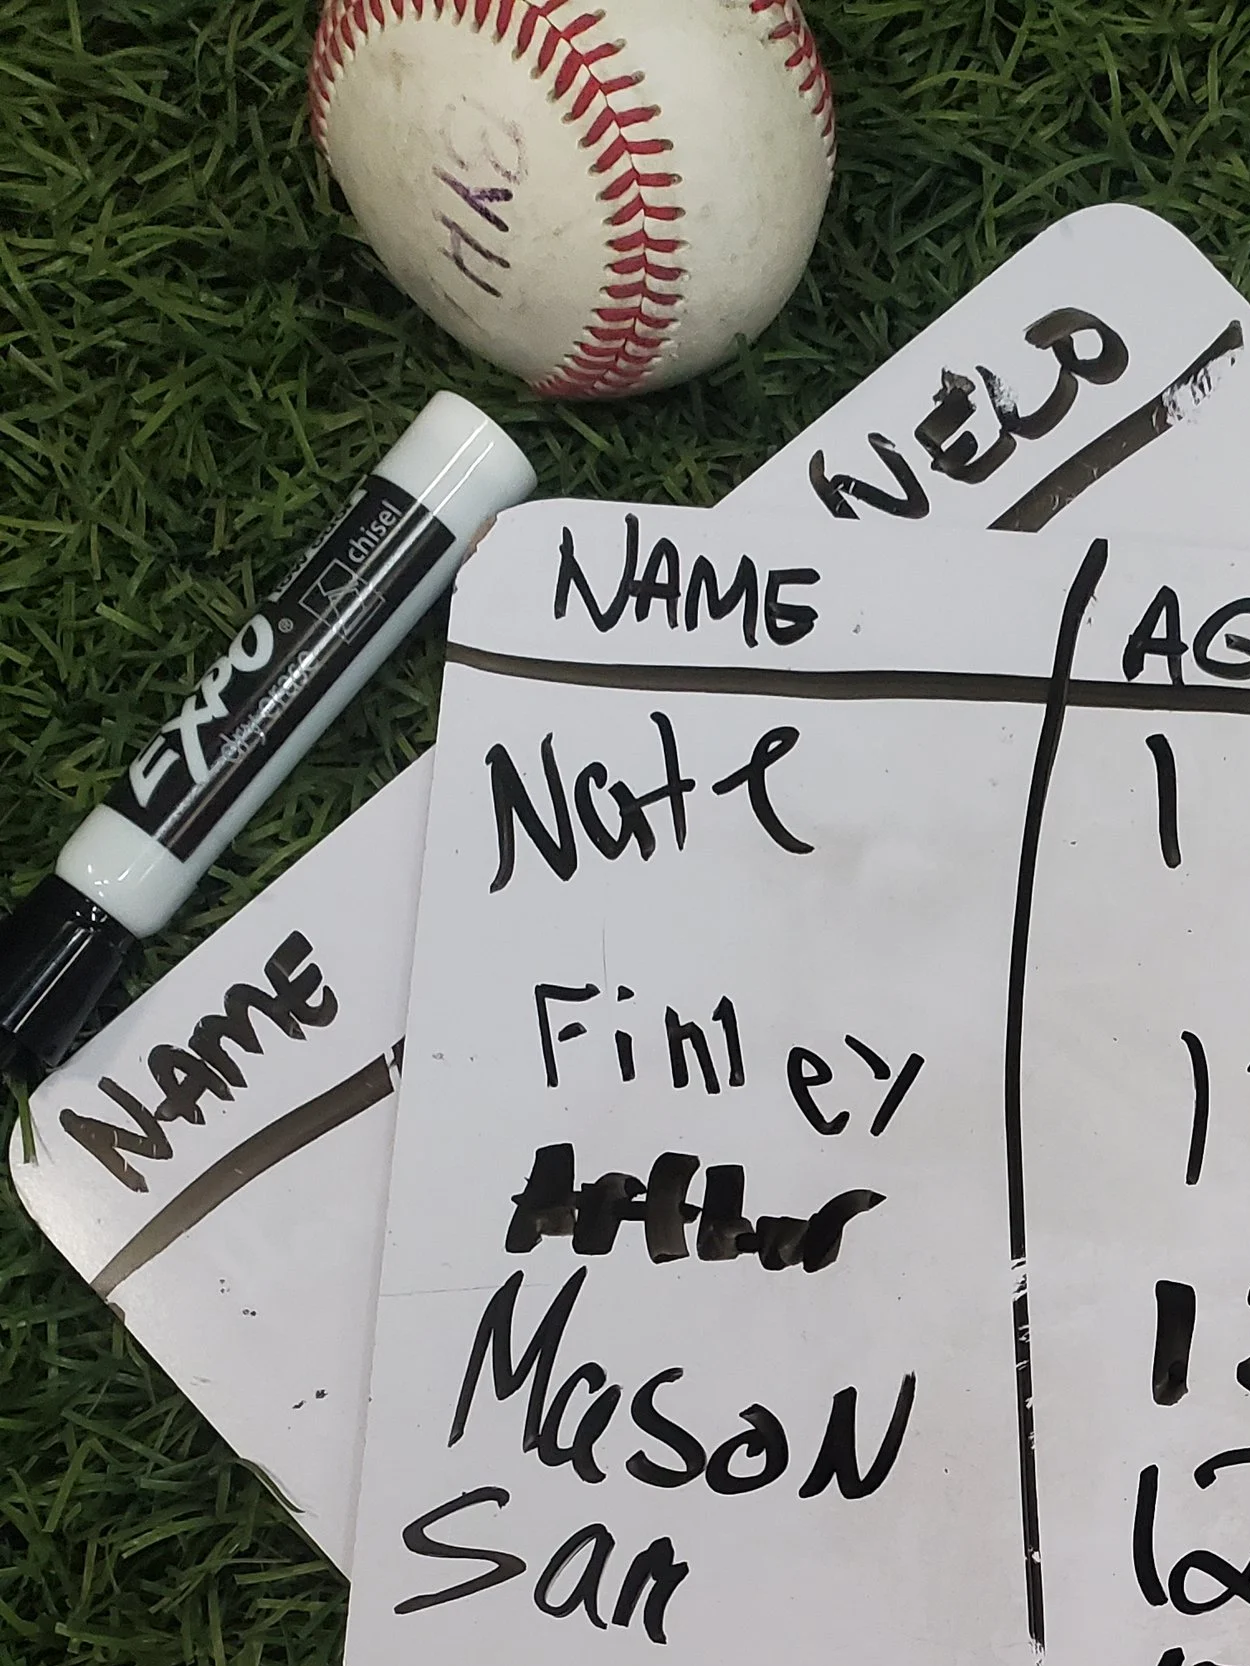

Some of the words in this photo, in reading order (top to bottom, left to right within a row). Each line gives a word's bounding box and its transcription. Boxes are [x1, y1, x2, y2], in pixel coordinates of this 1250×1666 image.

[347, 500, 404, 564] chisel
[553, 513, 821, 649] NAME
[128, 613, 275, 808] EXPO
[221, 714, 266, 762] dry
[484, 711, 815, 894] Nate
[57, 928, 340, 1194] NAME
[534, 983, 925, 1137] Finley
